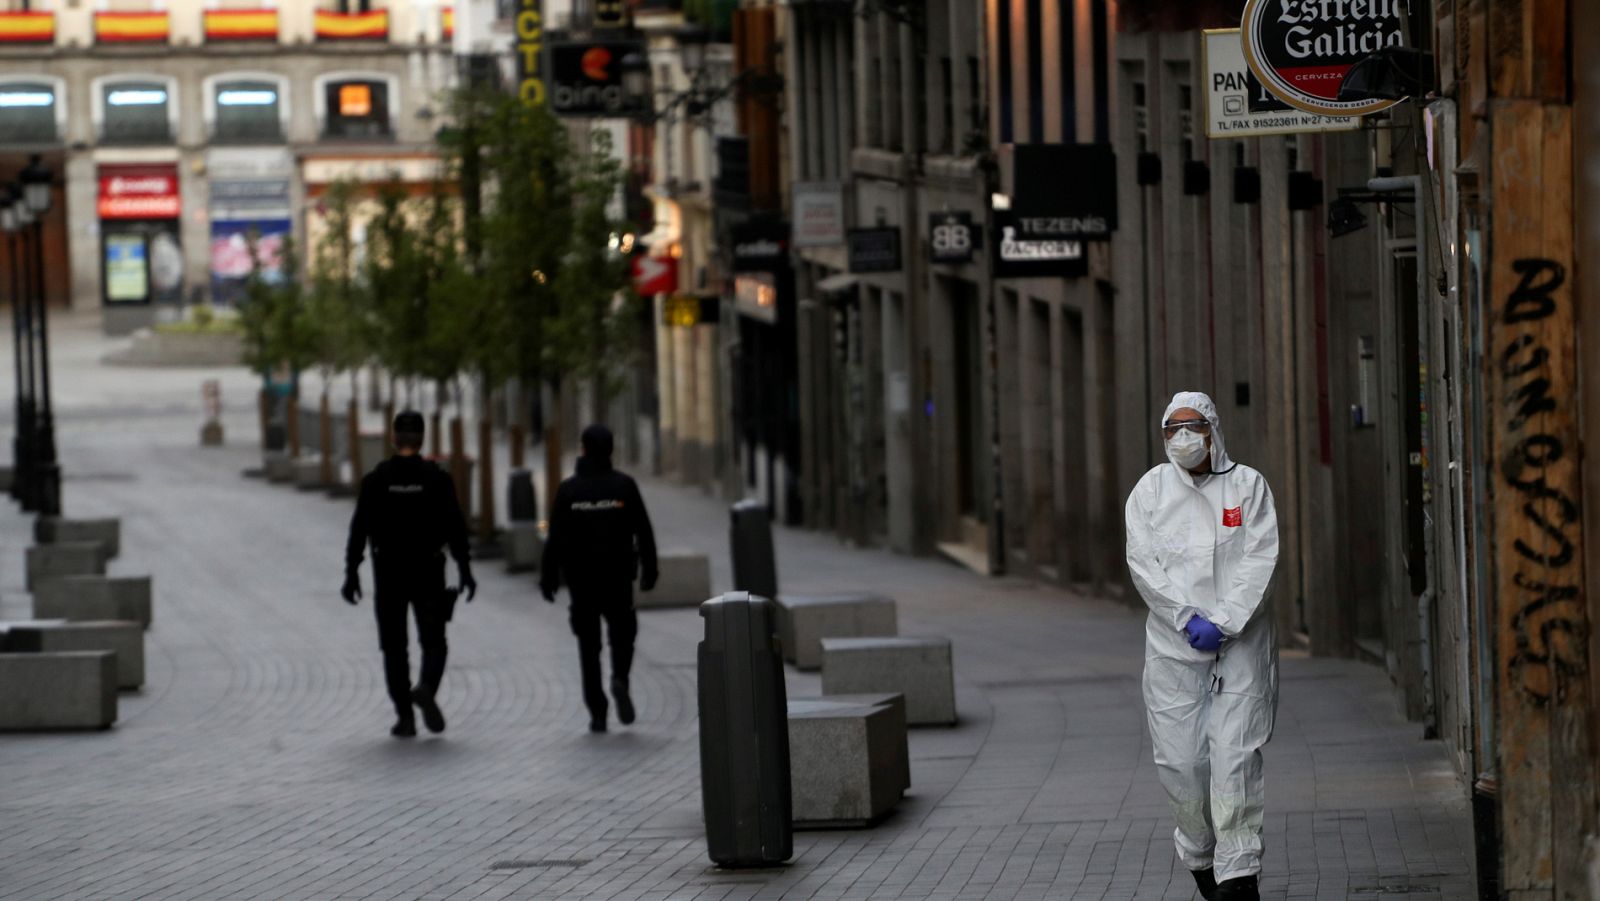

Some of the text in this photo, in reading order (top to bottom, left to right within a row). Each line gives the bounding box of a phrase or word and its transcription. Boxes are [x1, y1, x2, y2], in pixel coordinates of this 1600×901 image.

[1285, 22, 1404, 58] Galicia
[1301, 97, 1348, 108] CERVECEROS
[1351, 99, 1375, 107] DESDE
[1218, 119, 1250, 130] TL/FAX
[1253, 117, 1298, 128] 915223611
[1003, 240, 1080, 257] FACTORY
